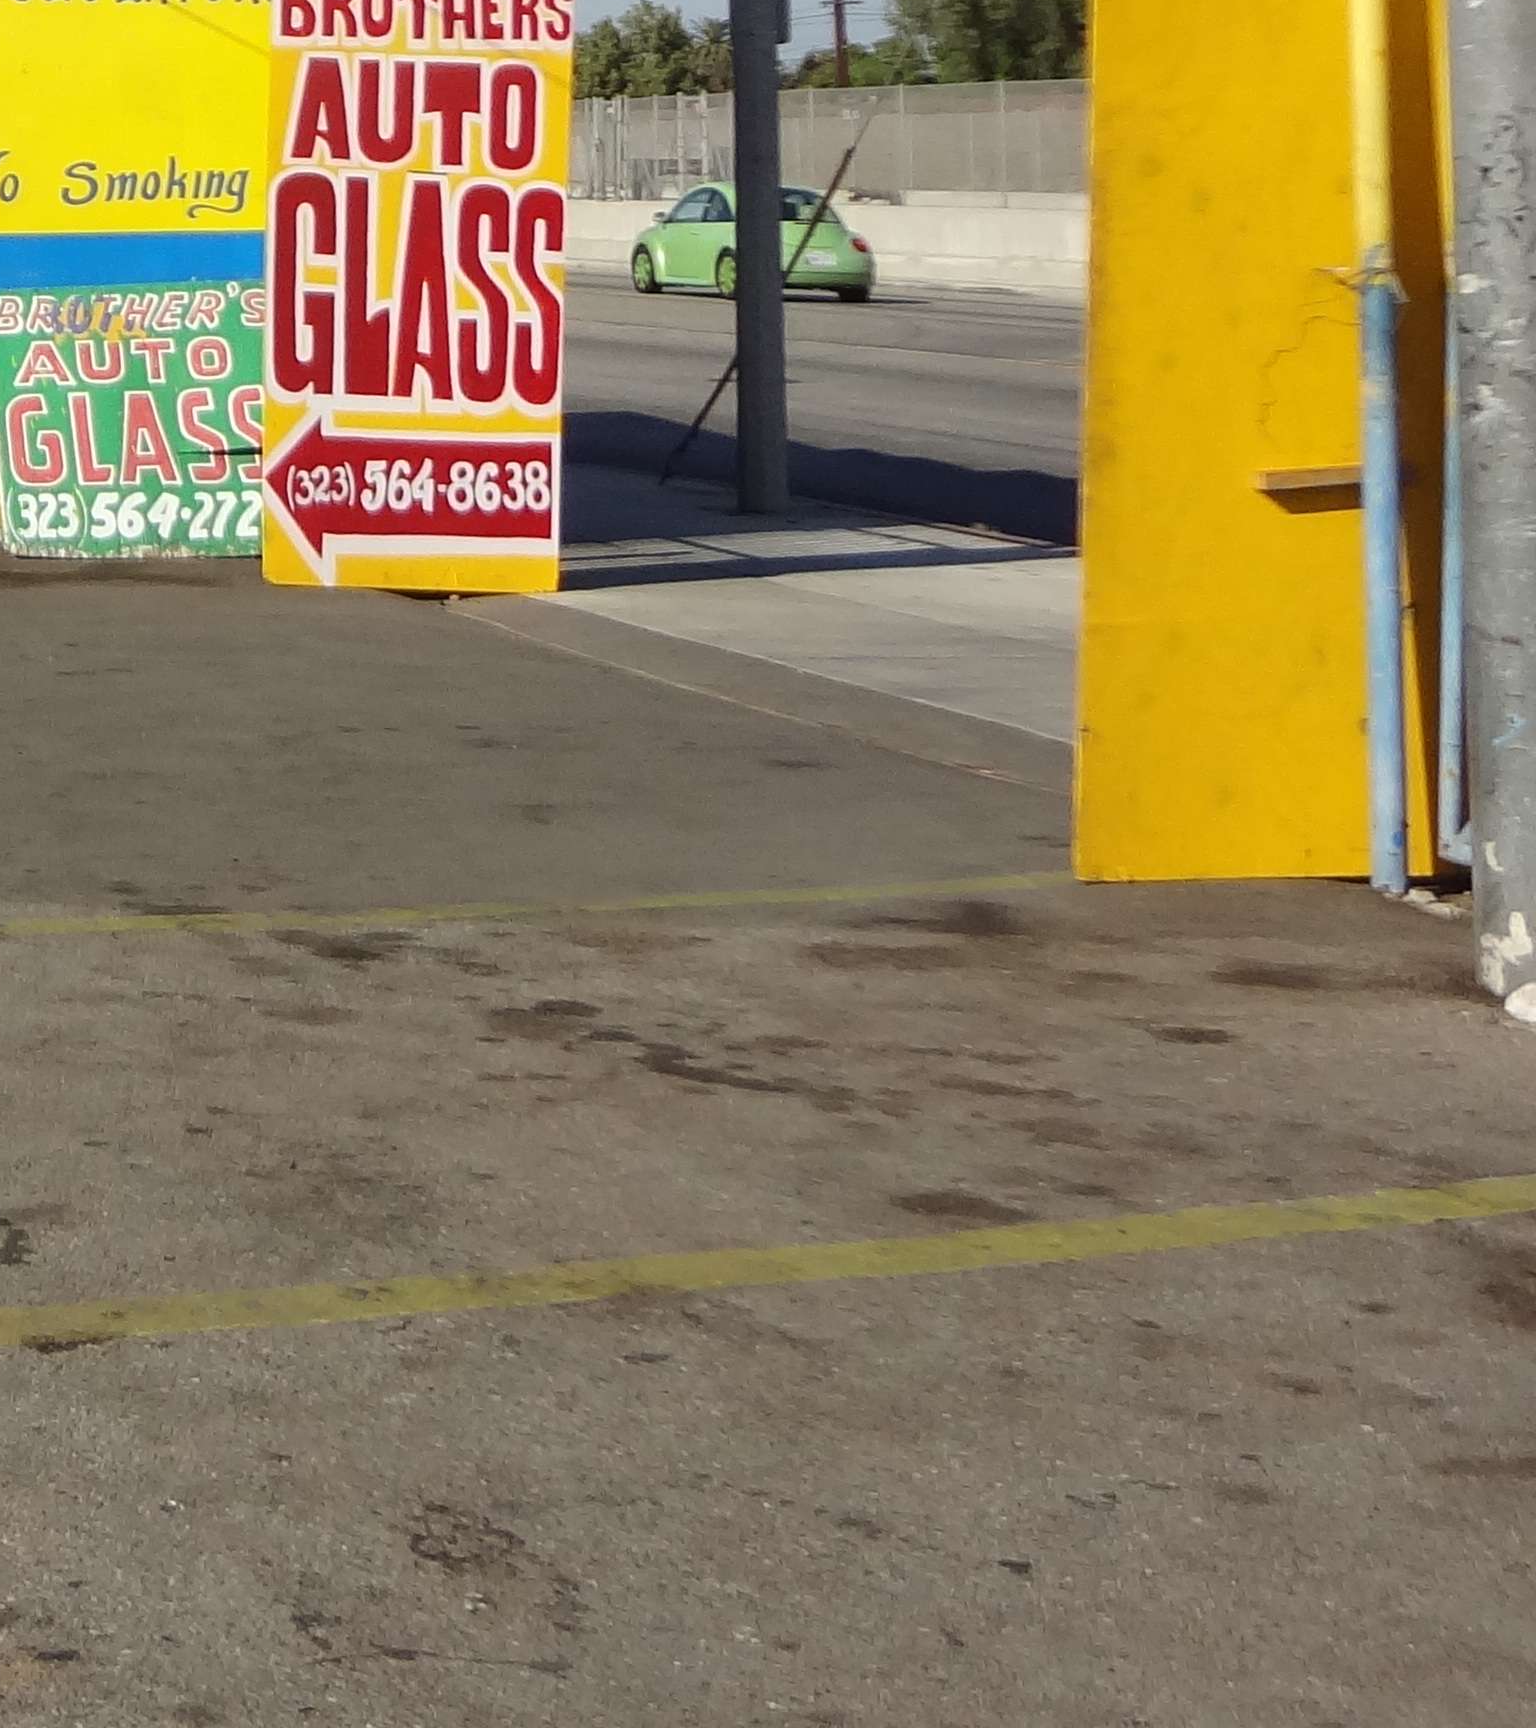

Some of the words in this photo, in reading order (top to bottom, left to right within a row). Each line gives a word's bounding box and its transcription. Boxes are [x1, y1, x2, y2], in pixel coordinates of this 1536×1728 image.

[284, 54, 542, 169] AUTO
[61, 155, 248, 220] Smoking
[271, 169, 567, 407] GLASS
[13, 336, 232, 386] AUTO
[5, 384, 264, 487] GLASS
